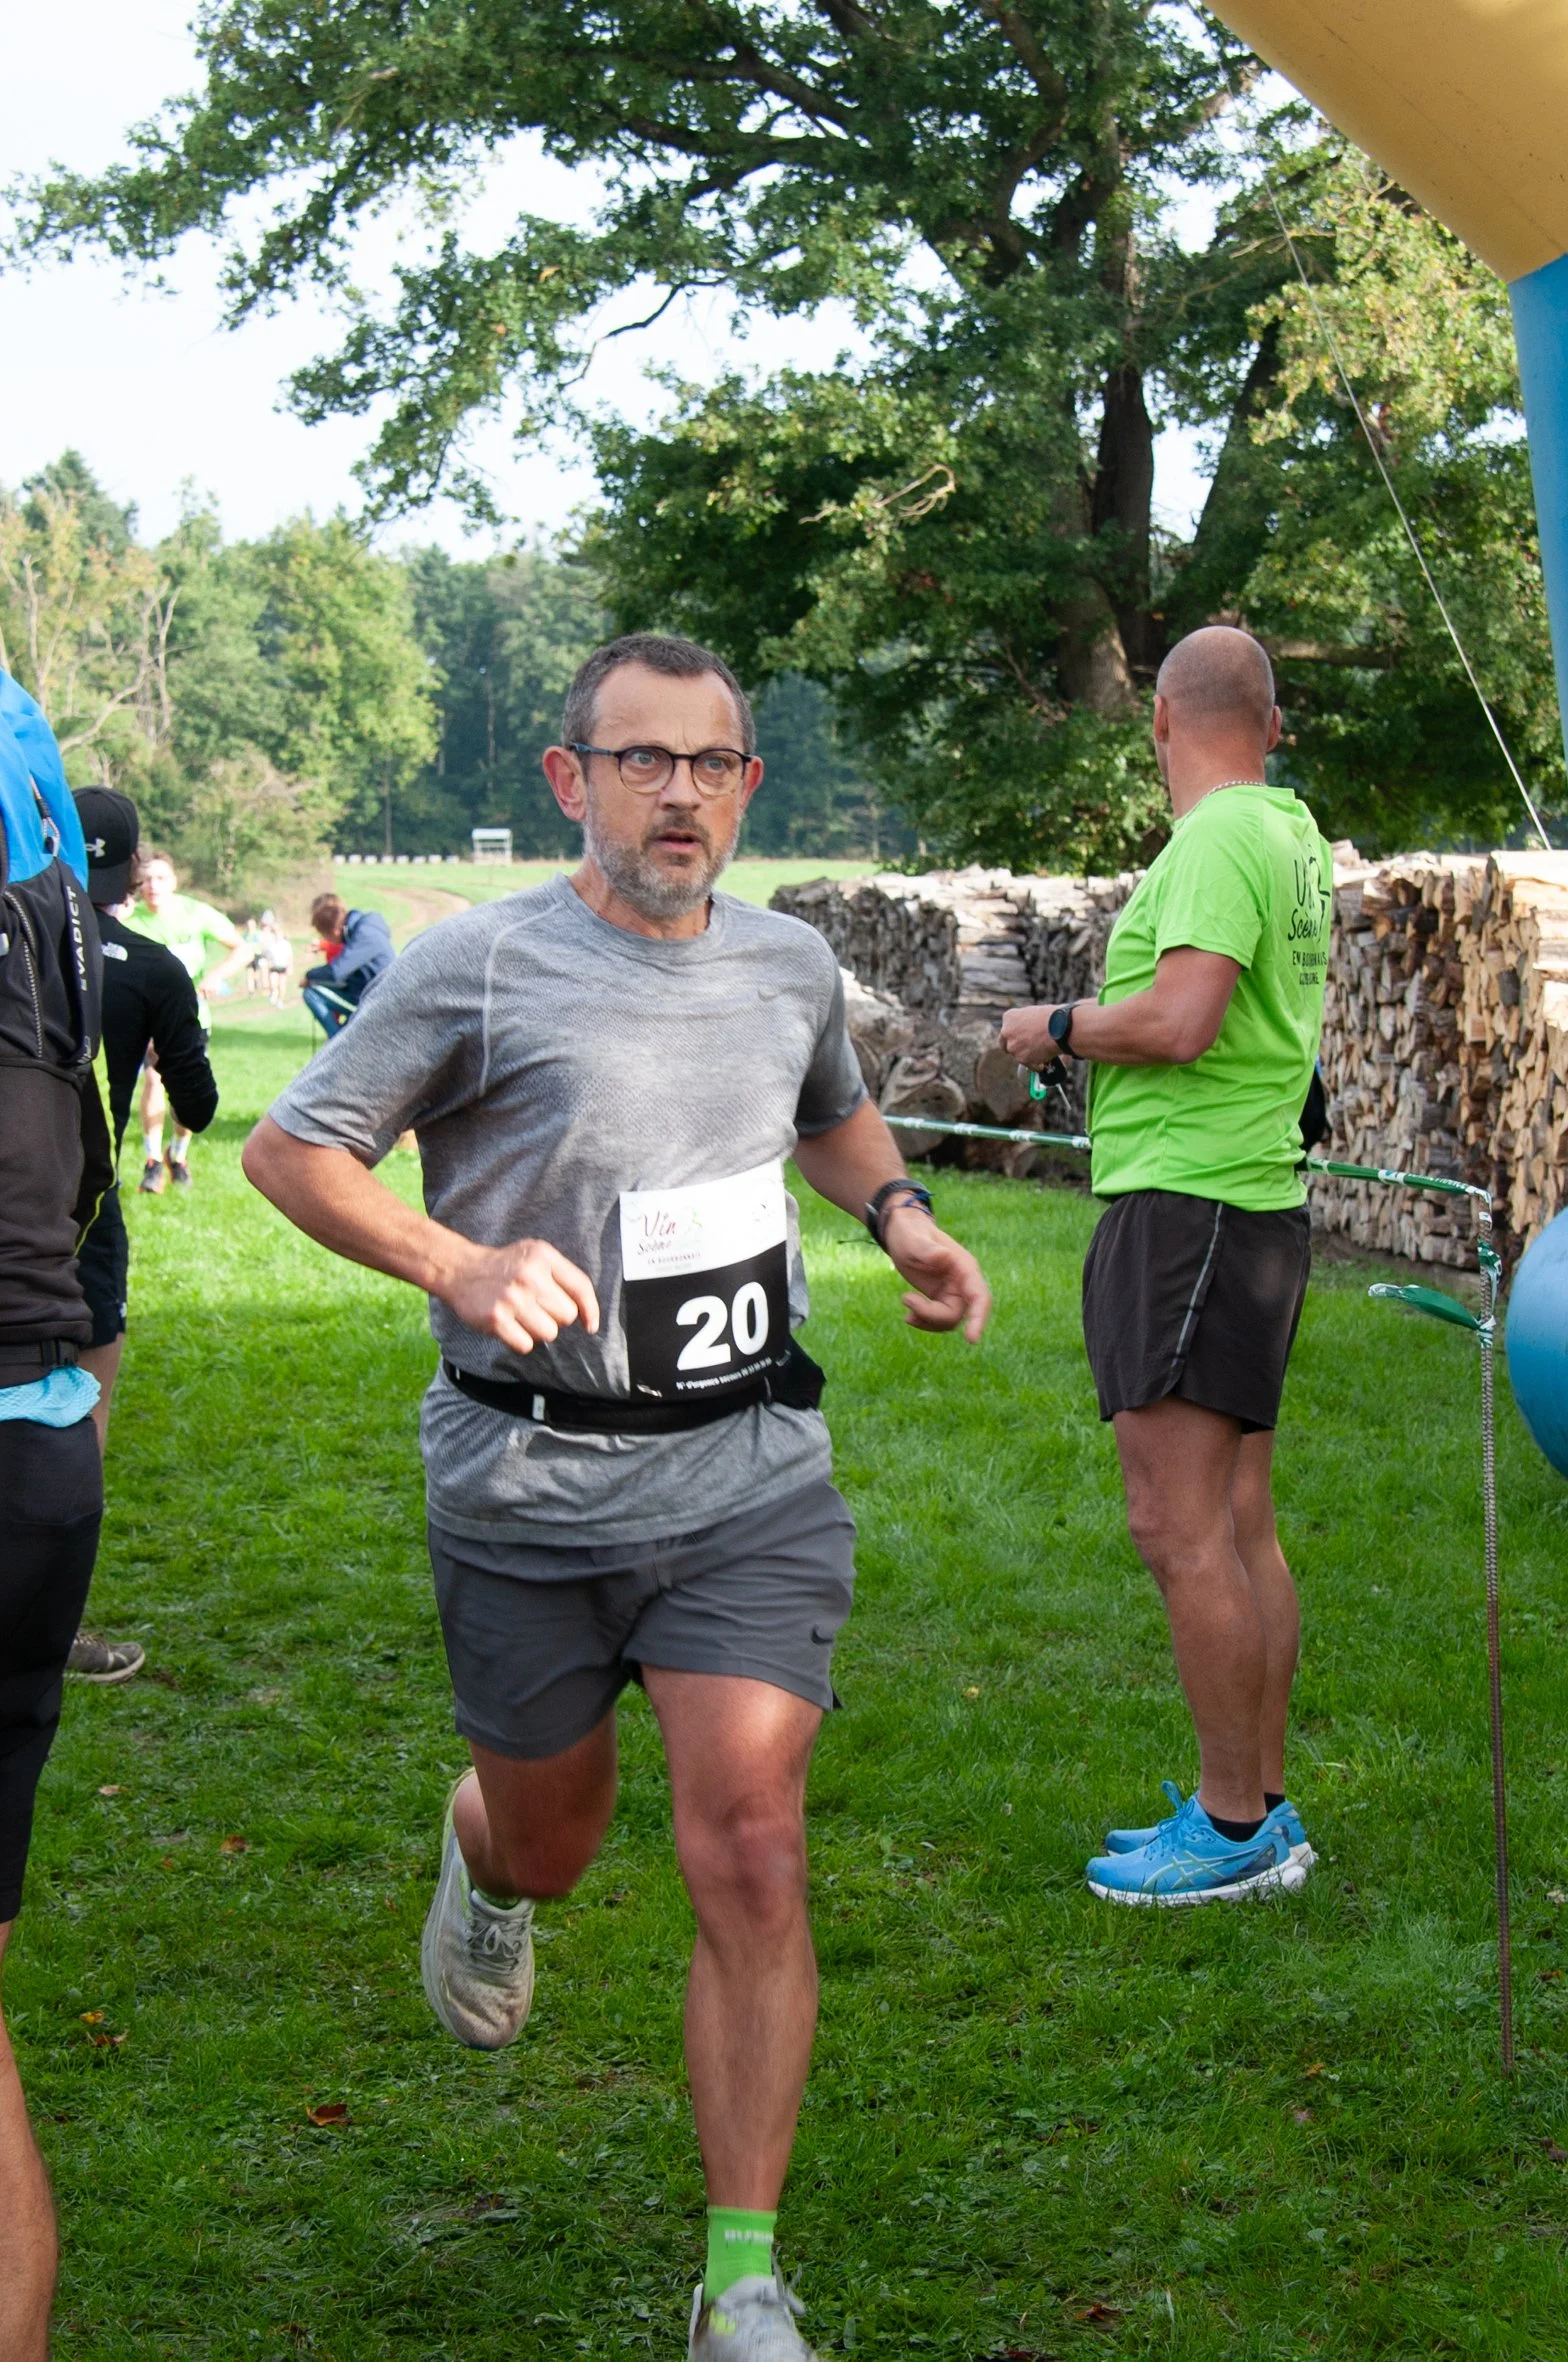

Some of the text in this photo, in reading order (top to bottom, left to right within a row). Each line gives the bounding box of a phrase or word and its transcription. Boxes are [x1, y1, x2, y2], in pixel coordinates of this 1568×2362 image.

[66, 886, 88, 992] EVADICT
[644, 1210, 676, 1237] Vin
[676, 1281, 769, 1371] 20
